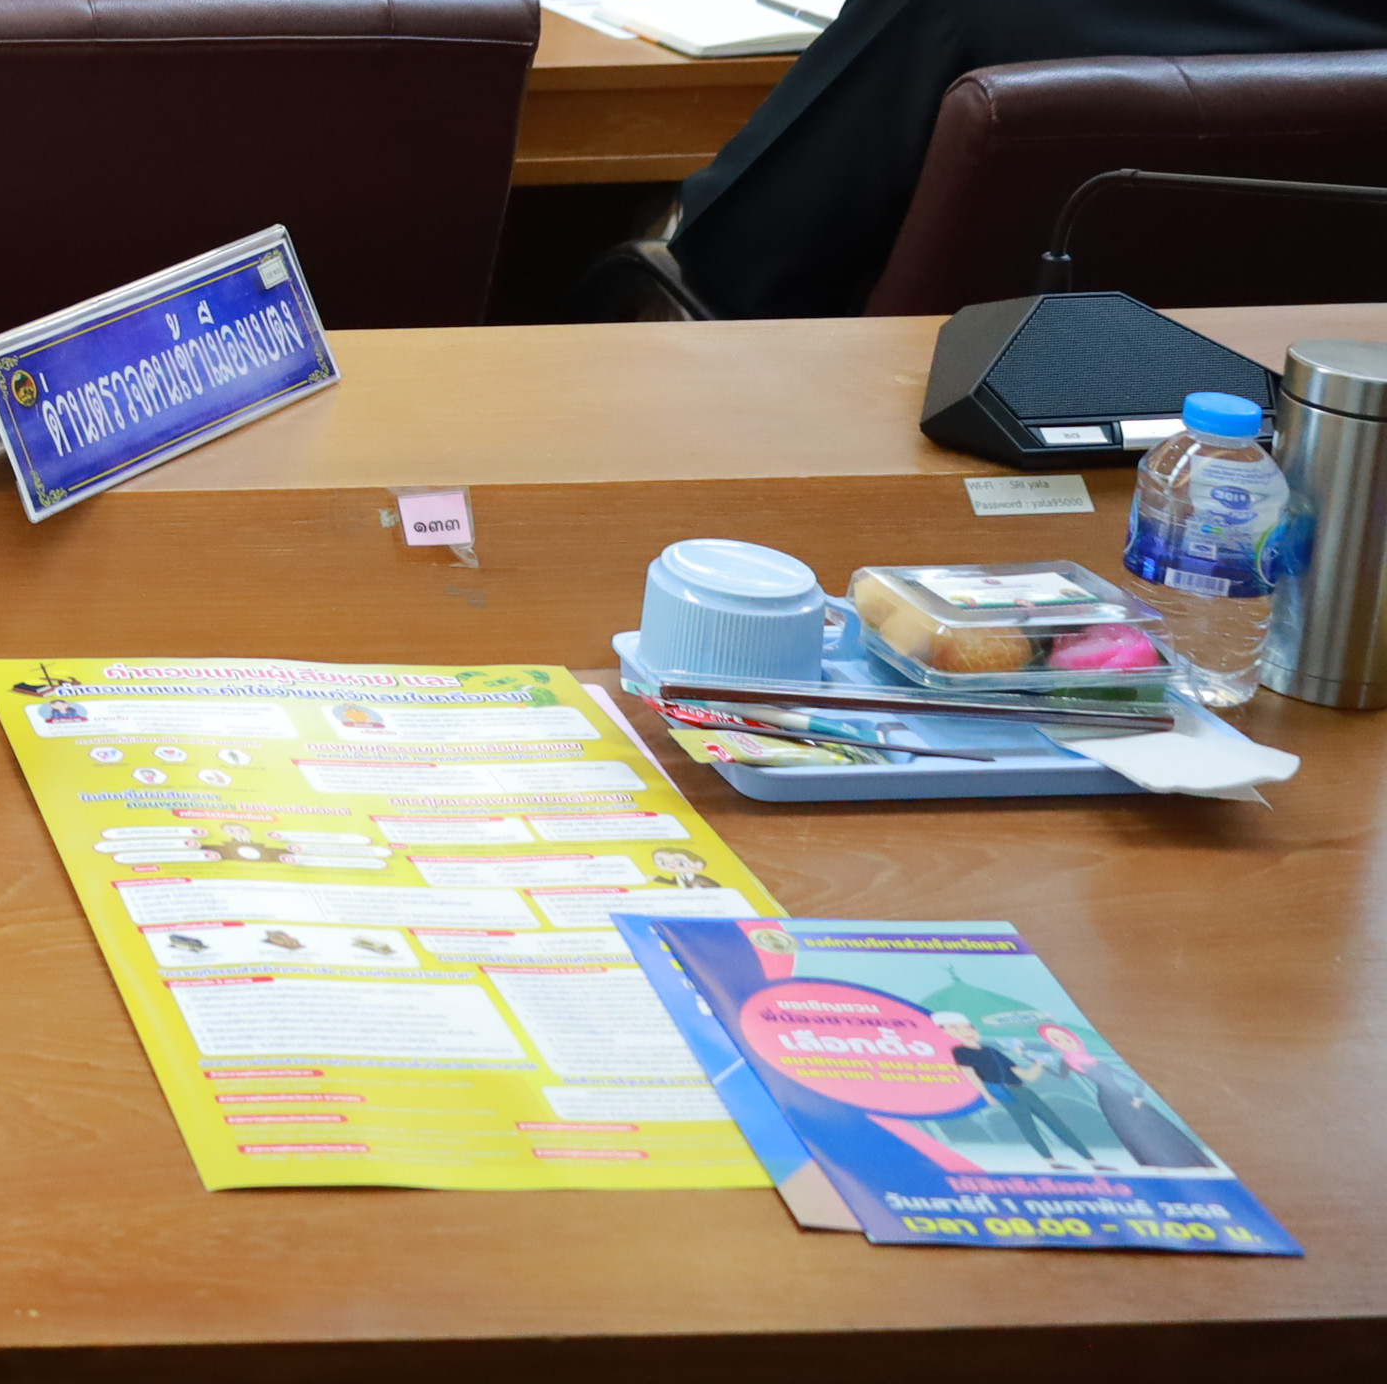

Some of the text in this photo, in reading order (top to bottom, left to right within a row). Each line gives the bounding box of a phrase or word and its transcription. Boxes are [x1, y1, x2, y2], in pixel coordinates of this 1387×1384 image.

[42, 300, 305, 457] ด่านตรวจคนเข้าเมืองเบตง
[975, 500, 1022, 510] Password
[412, 516, 461, 536] ๑๓๓
[104, 664, 460, 688] ค่าตอบแทนผู้เสียหาย และ
[779, 1026, 936, 1058] เลือกตั้ง
[885, 1191, 996, 1215] วันเสาร์ที่
[1005, 1198, 1017, 1213] 1
[1158, 1202, 1232, 1220] 2568
[902, 1215, 977, 1236] เวลา
[984, 1217, 1094, 1237] 08.00
[1127, 1219, 1217, 1240] 17.00
[1226, 1225, 1263, 1243] น.
